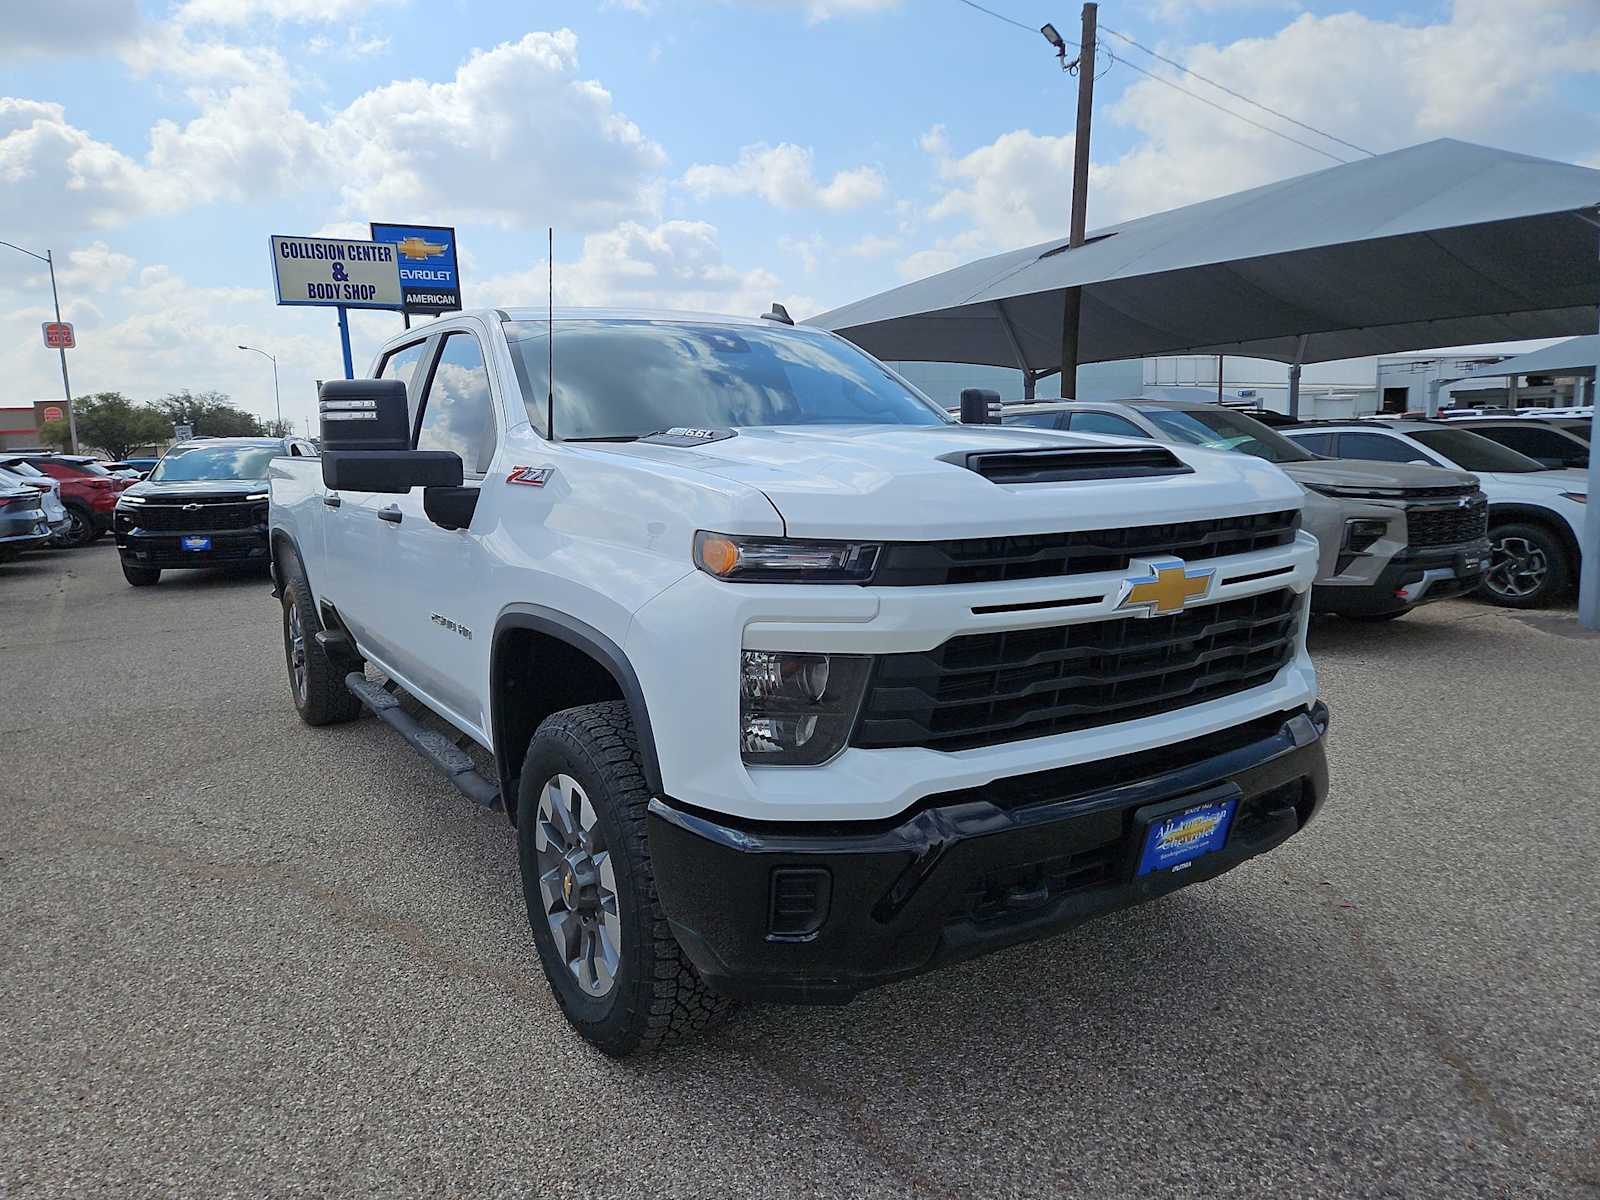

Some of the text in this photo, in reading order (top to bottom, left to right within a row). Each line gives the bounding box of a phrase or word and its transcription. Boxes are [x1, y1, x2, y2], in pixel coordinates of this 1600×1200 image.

[281, 242, 392, 262] COLLISION CENTER
[332, 262, 349, 282] &
[400, 269, 451, 281] EVROLET
[308, 283, 376, 300] BODY SHOP
[406, 294, 456, 305] AMERICAN
[506, 465, 555, 488] Z71
